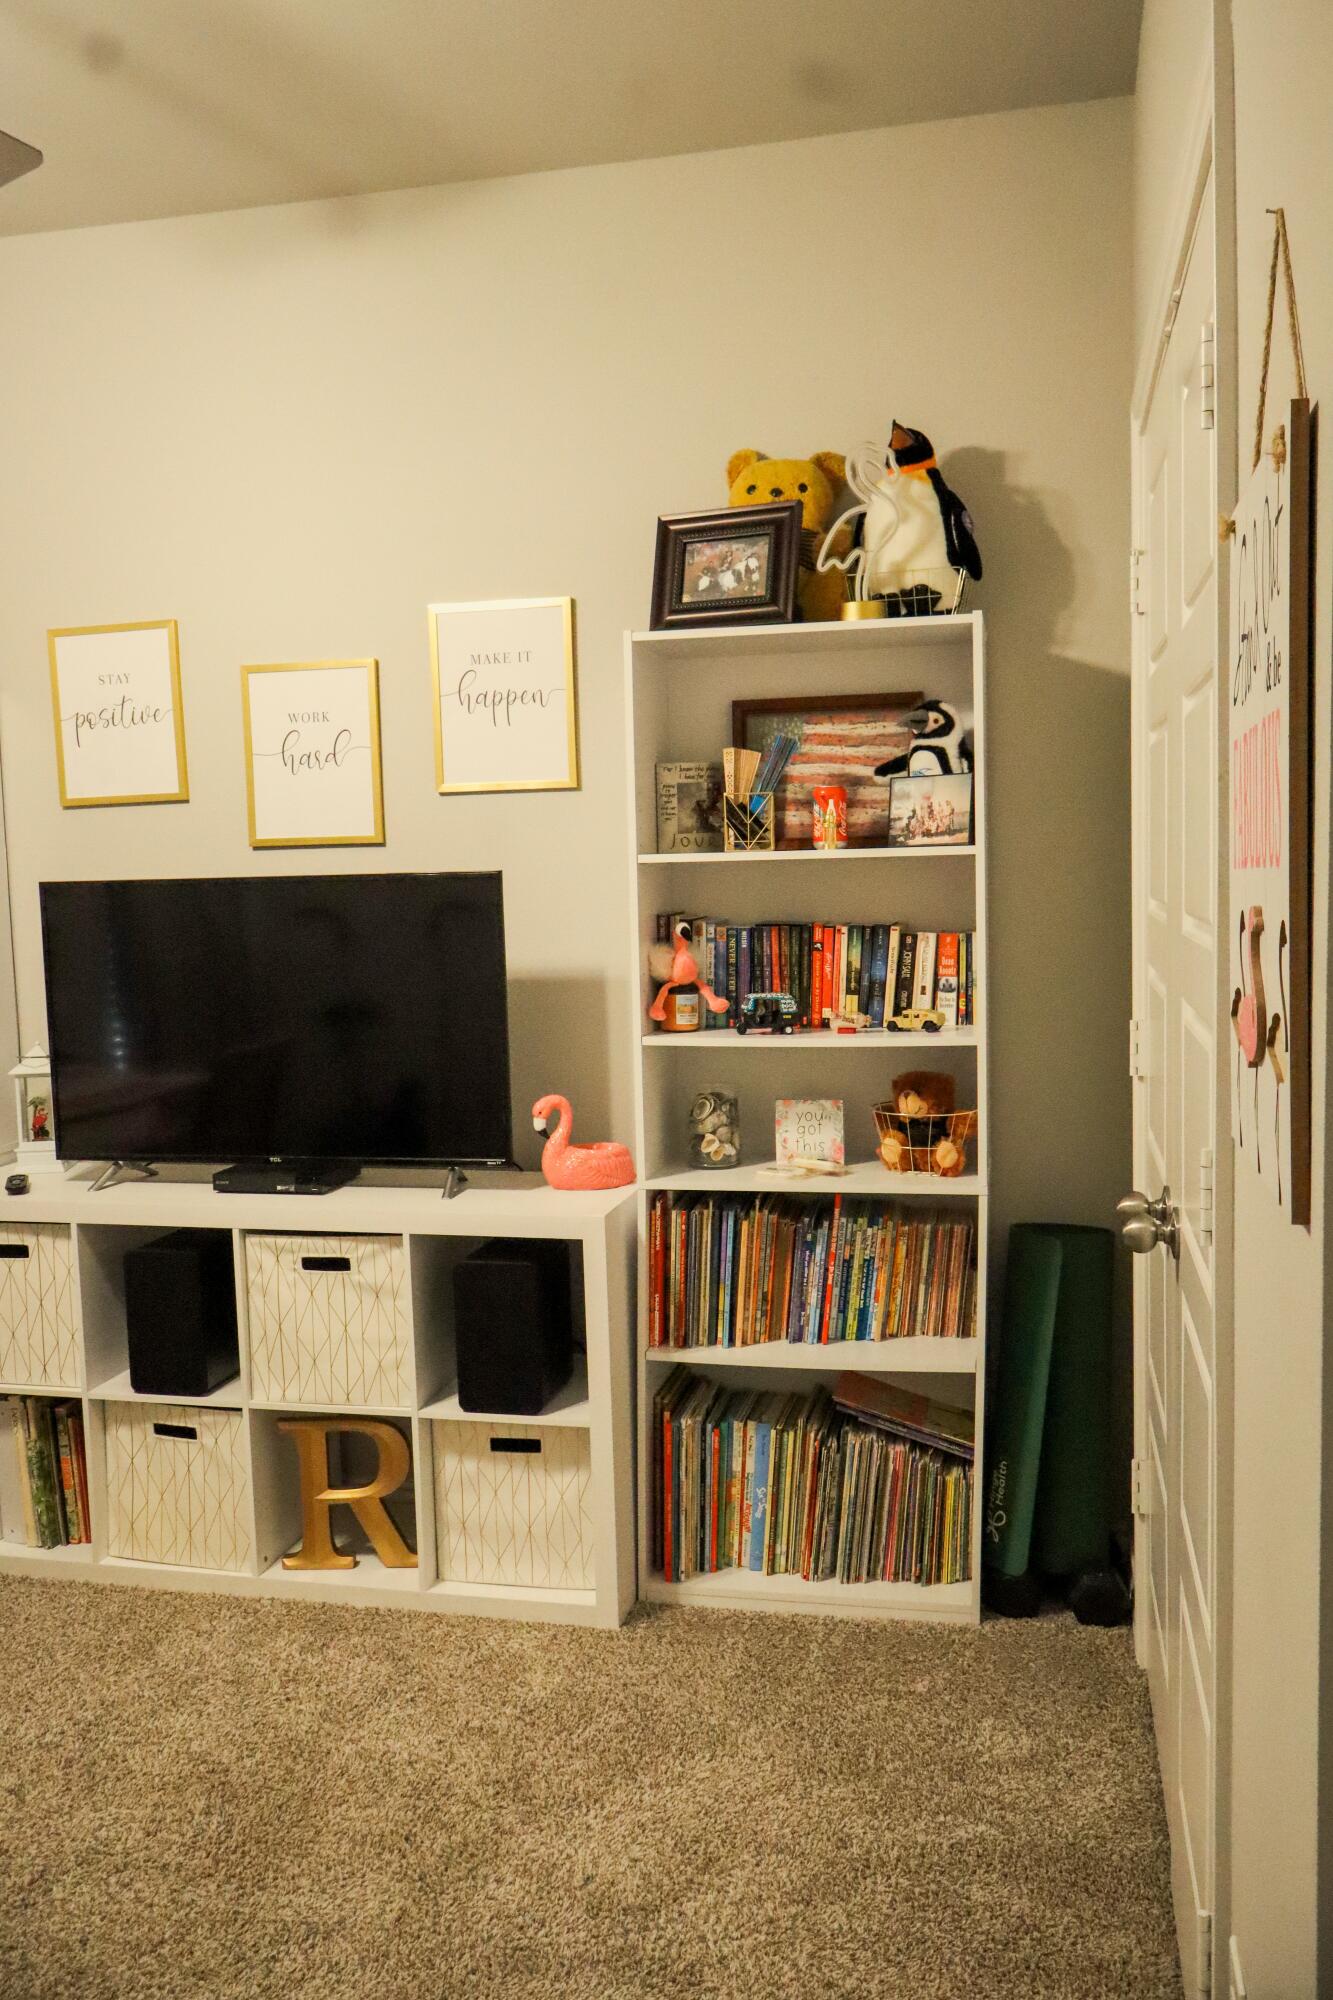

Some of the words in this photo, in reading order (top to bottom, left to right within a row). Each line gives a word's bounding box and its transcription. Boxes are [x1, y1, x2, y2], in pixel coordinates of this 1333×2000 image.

[1262, 496, 1283, 634] Out
[470, 651, 511, 666] MAKE
[518, 650, 532, 663] IT
[1273, 635, 1282, 688] be
[98, 672, 131, 685] STAY
[442, 669, 565, 727] happen
[62, 695, 172, 748] positive
[288, 711, 330, 723] WORK
[257, 729, 369, 775] hard
[1233, 708, 1282, 869] FABULOUS
[728, 938, 736, 963] NEVER
[902, 950, 912, 965] JOHN
[796, 1111, 824, 1126] you
[797, 1121, 822, 1139] got
[793, 1138, 825, 1153] this
[278, 1418, 418, 1569] R
[995, 1460, 1007, 1505] Health
